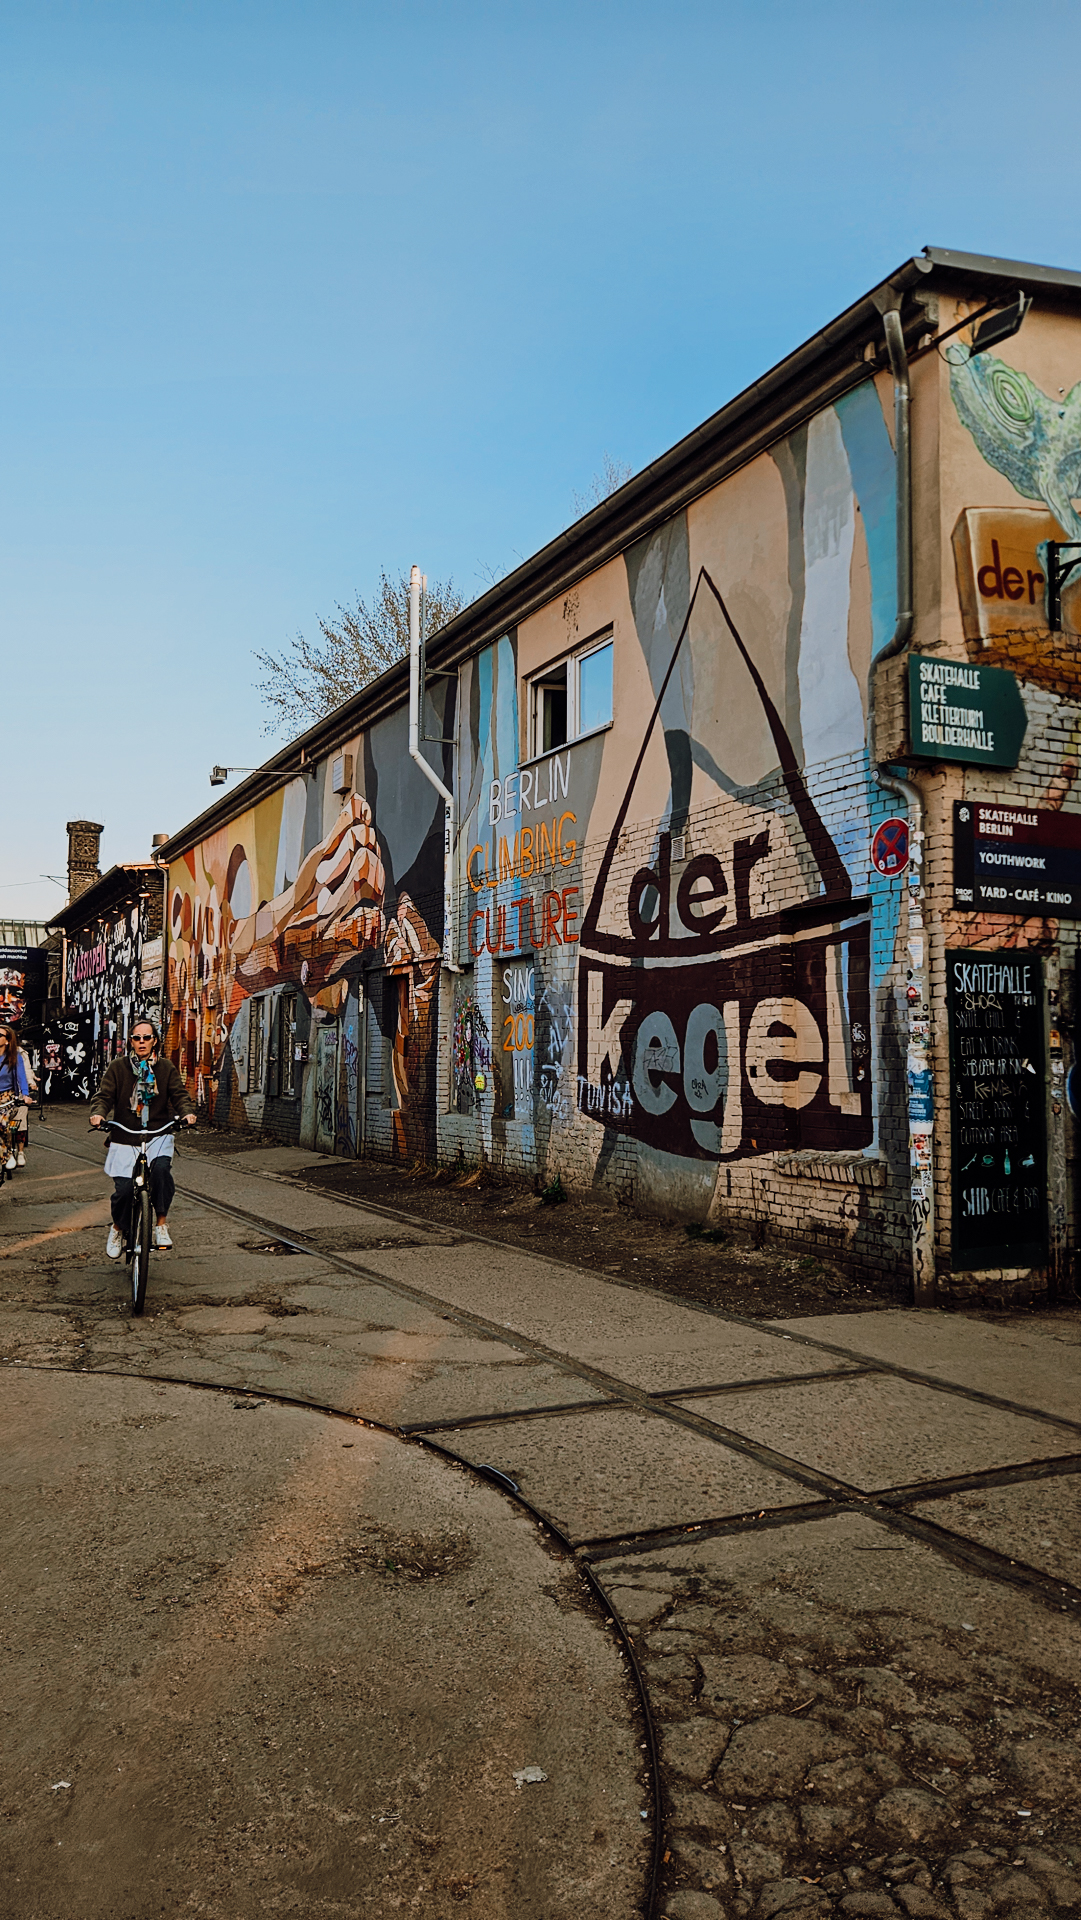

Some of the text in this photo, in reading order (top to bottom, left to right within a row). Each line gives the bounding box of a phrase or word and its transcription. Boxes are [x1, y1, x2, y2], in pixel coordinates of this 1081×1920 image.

[977, 538, 1045, 605] der
[919, 662, 981, 690] SKATEHALLE
[921, 702, 984, 729] KLETTERTURM
[922, 723, 995, 752] BOULDERHALLE
[488, 749, 572, 827] BERLIN
[978, 808, 1039, 826] SKATEHALLE
[978, 822, 1014, 837] BERLIN
[466, 810, 578, 893] CLIMBING
[978, 851, 1046, 869] YOUTHWORK
[627, 829, 773, 941] der
[467, 886, 580, 958] CULTURE
[953, 962, 1032, 994] SKATEHALLE
[587, 941, 862, 1155] kegel
[960, 1036, 975, 1056] EAT
[992, 1035, 1020, 1056] DRINK
[960, 1125, 1019, 1145] OUTDOOR AREA
[961, 1187, 990, 1217] SHB
